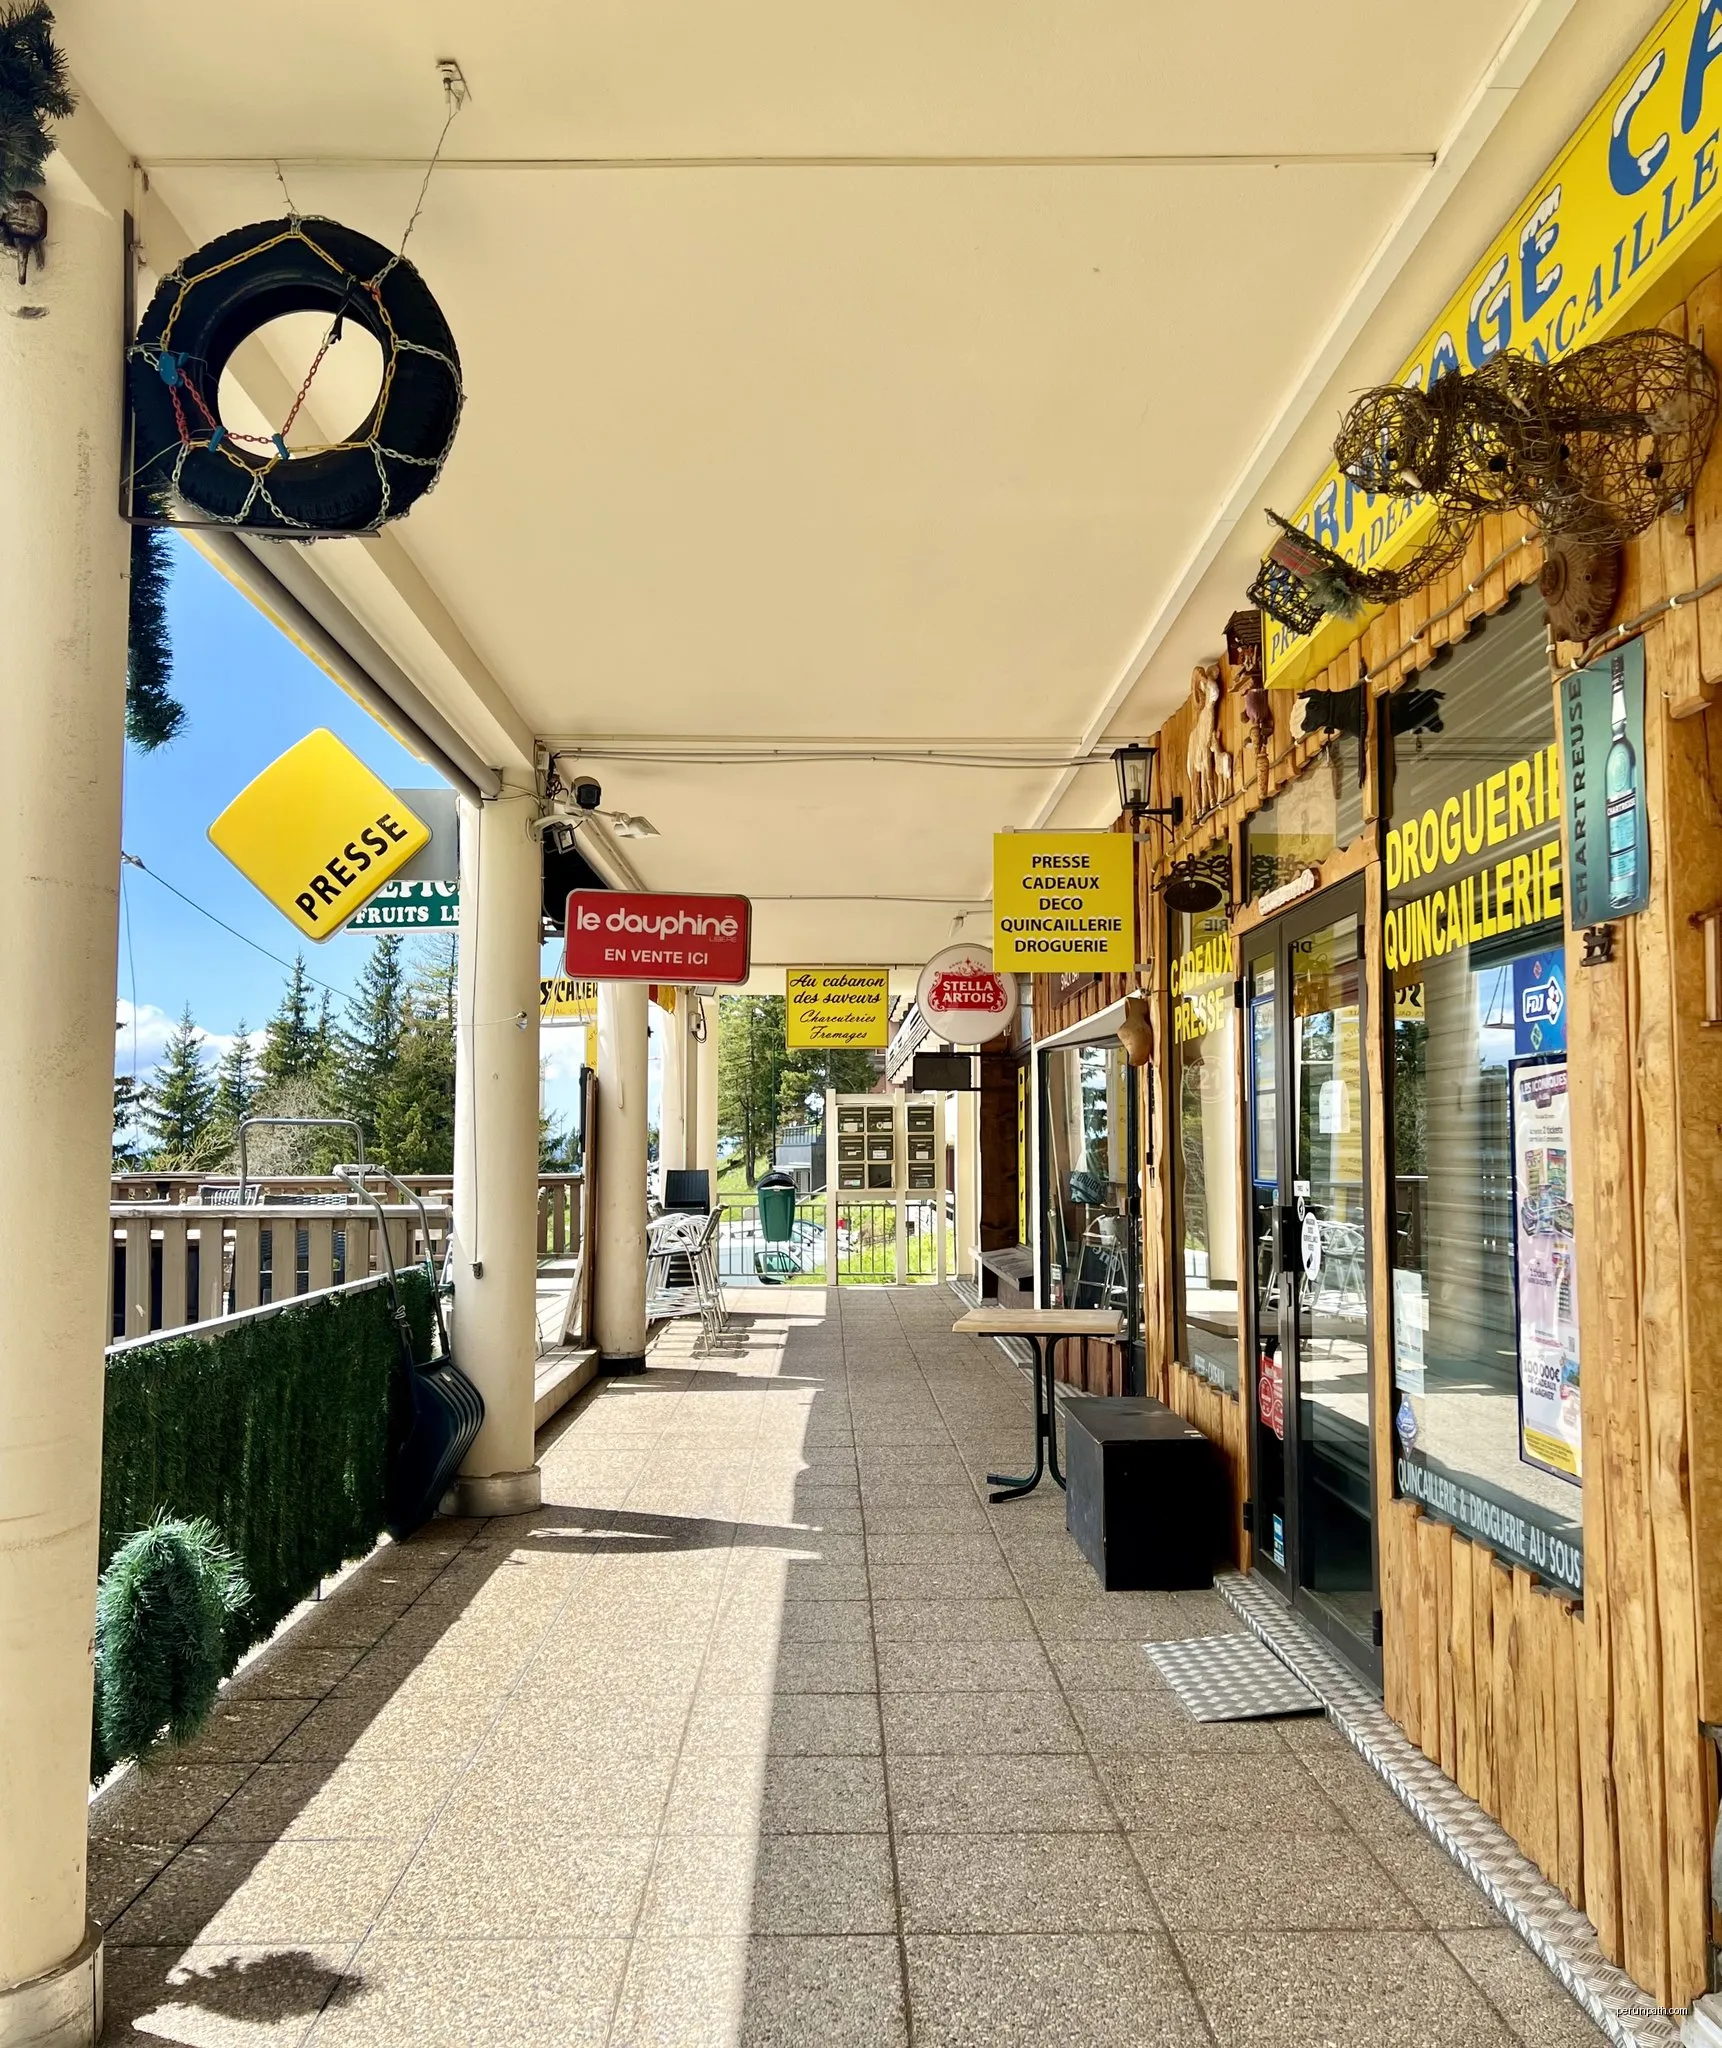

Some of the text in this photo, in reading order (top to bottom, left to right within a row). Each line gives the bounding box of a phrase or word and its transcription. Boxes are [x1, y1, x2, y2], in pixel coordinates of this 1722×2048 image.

[1568, 677, 1589, 921] CHARTREUSE
[1386, 743, 1560, 891] DROGUERIE
[295, 813, 408, 922] PRESSE
[1031, 855, 1090, 869] PRESSE
[1022, 876, 1100, 890] CADEAUX
[1039, 897, 1083, 911] DECO
[1384, 840, 1562, 972] QUINCAILLERIE
[355, 905, 429, 924] FRUITS
[576, 905, 601, 932] le
[1000, 918, 1122, 933] QUINCAILLERIE
[1014, 939, 1108, 953] DROGUERIE
[604, 948, 709, 966] EN VENTE ICI
[1171, 932, 1233, 998] CADEAUX
[789, 973, 886, 988] Au cabanon
[942, 980, 994, 992] STELLA
[793, 990, 882, 1004] des saveurs
[942, 992, 995, 1003] ARTOIS
[1526, 993, 1545, 1015] FDJ
[799, 1009, 877, 1024] Charcuteries
[1174, 986, 1225, 1045] PRESSE
[809, 1025, 868, 1044] Fromages
[1397, 1457, 1581, 1589] QUINCAILLERIE & DROGUERIE AU SOUS
